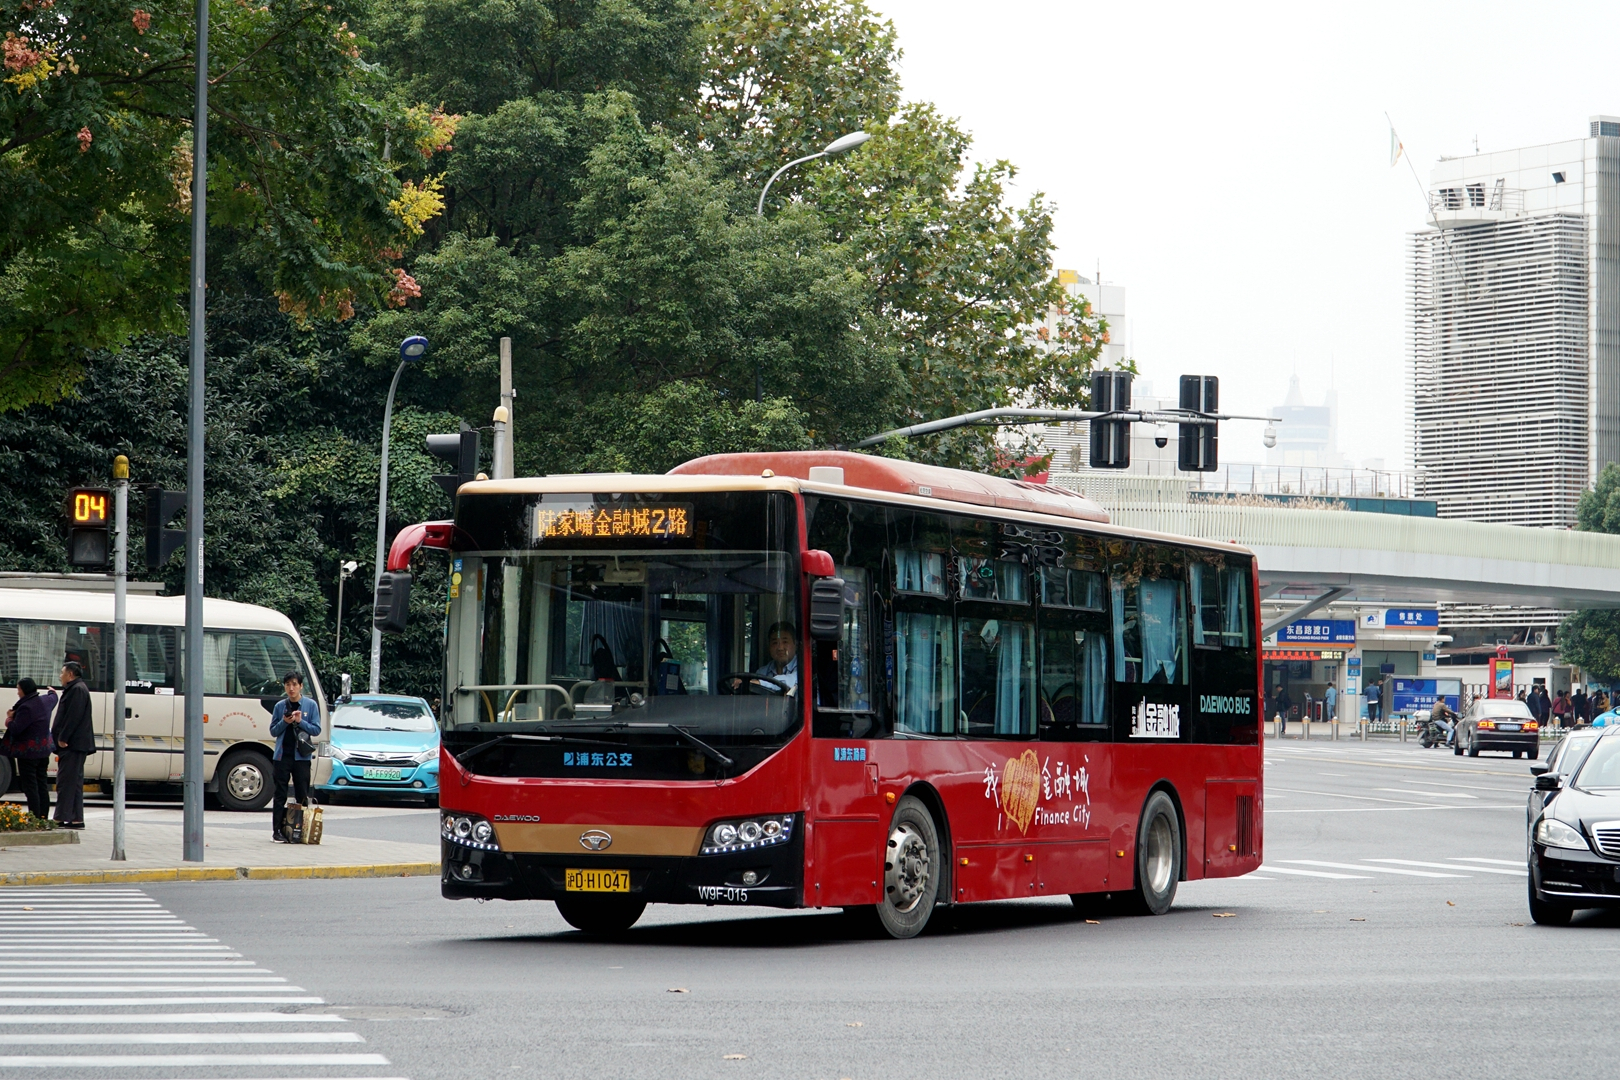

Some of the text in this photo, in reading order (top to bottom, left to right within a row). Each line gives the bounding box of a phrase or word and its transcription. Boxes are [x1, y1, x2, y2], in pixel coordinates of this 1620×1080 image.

[75, 494, 105, 520] 04
[537, 508, 688, 537] 陆家嘴金融城2路
[1399, 612, 1423, 621] 售票处
[1286, 624, 1330, 635] 东昌路渡口
[1200, 694, 1251, 714] DAEWOO BUS
[576, 752, 633, 767] 浦东公交
[494, 814, 541, 822] DAEWOO
[1034, 806, 1070, 826] Finance
[1072, 804, 1091, 831] City
[698, 886, 748, 902] W9F-015
